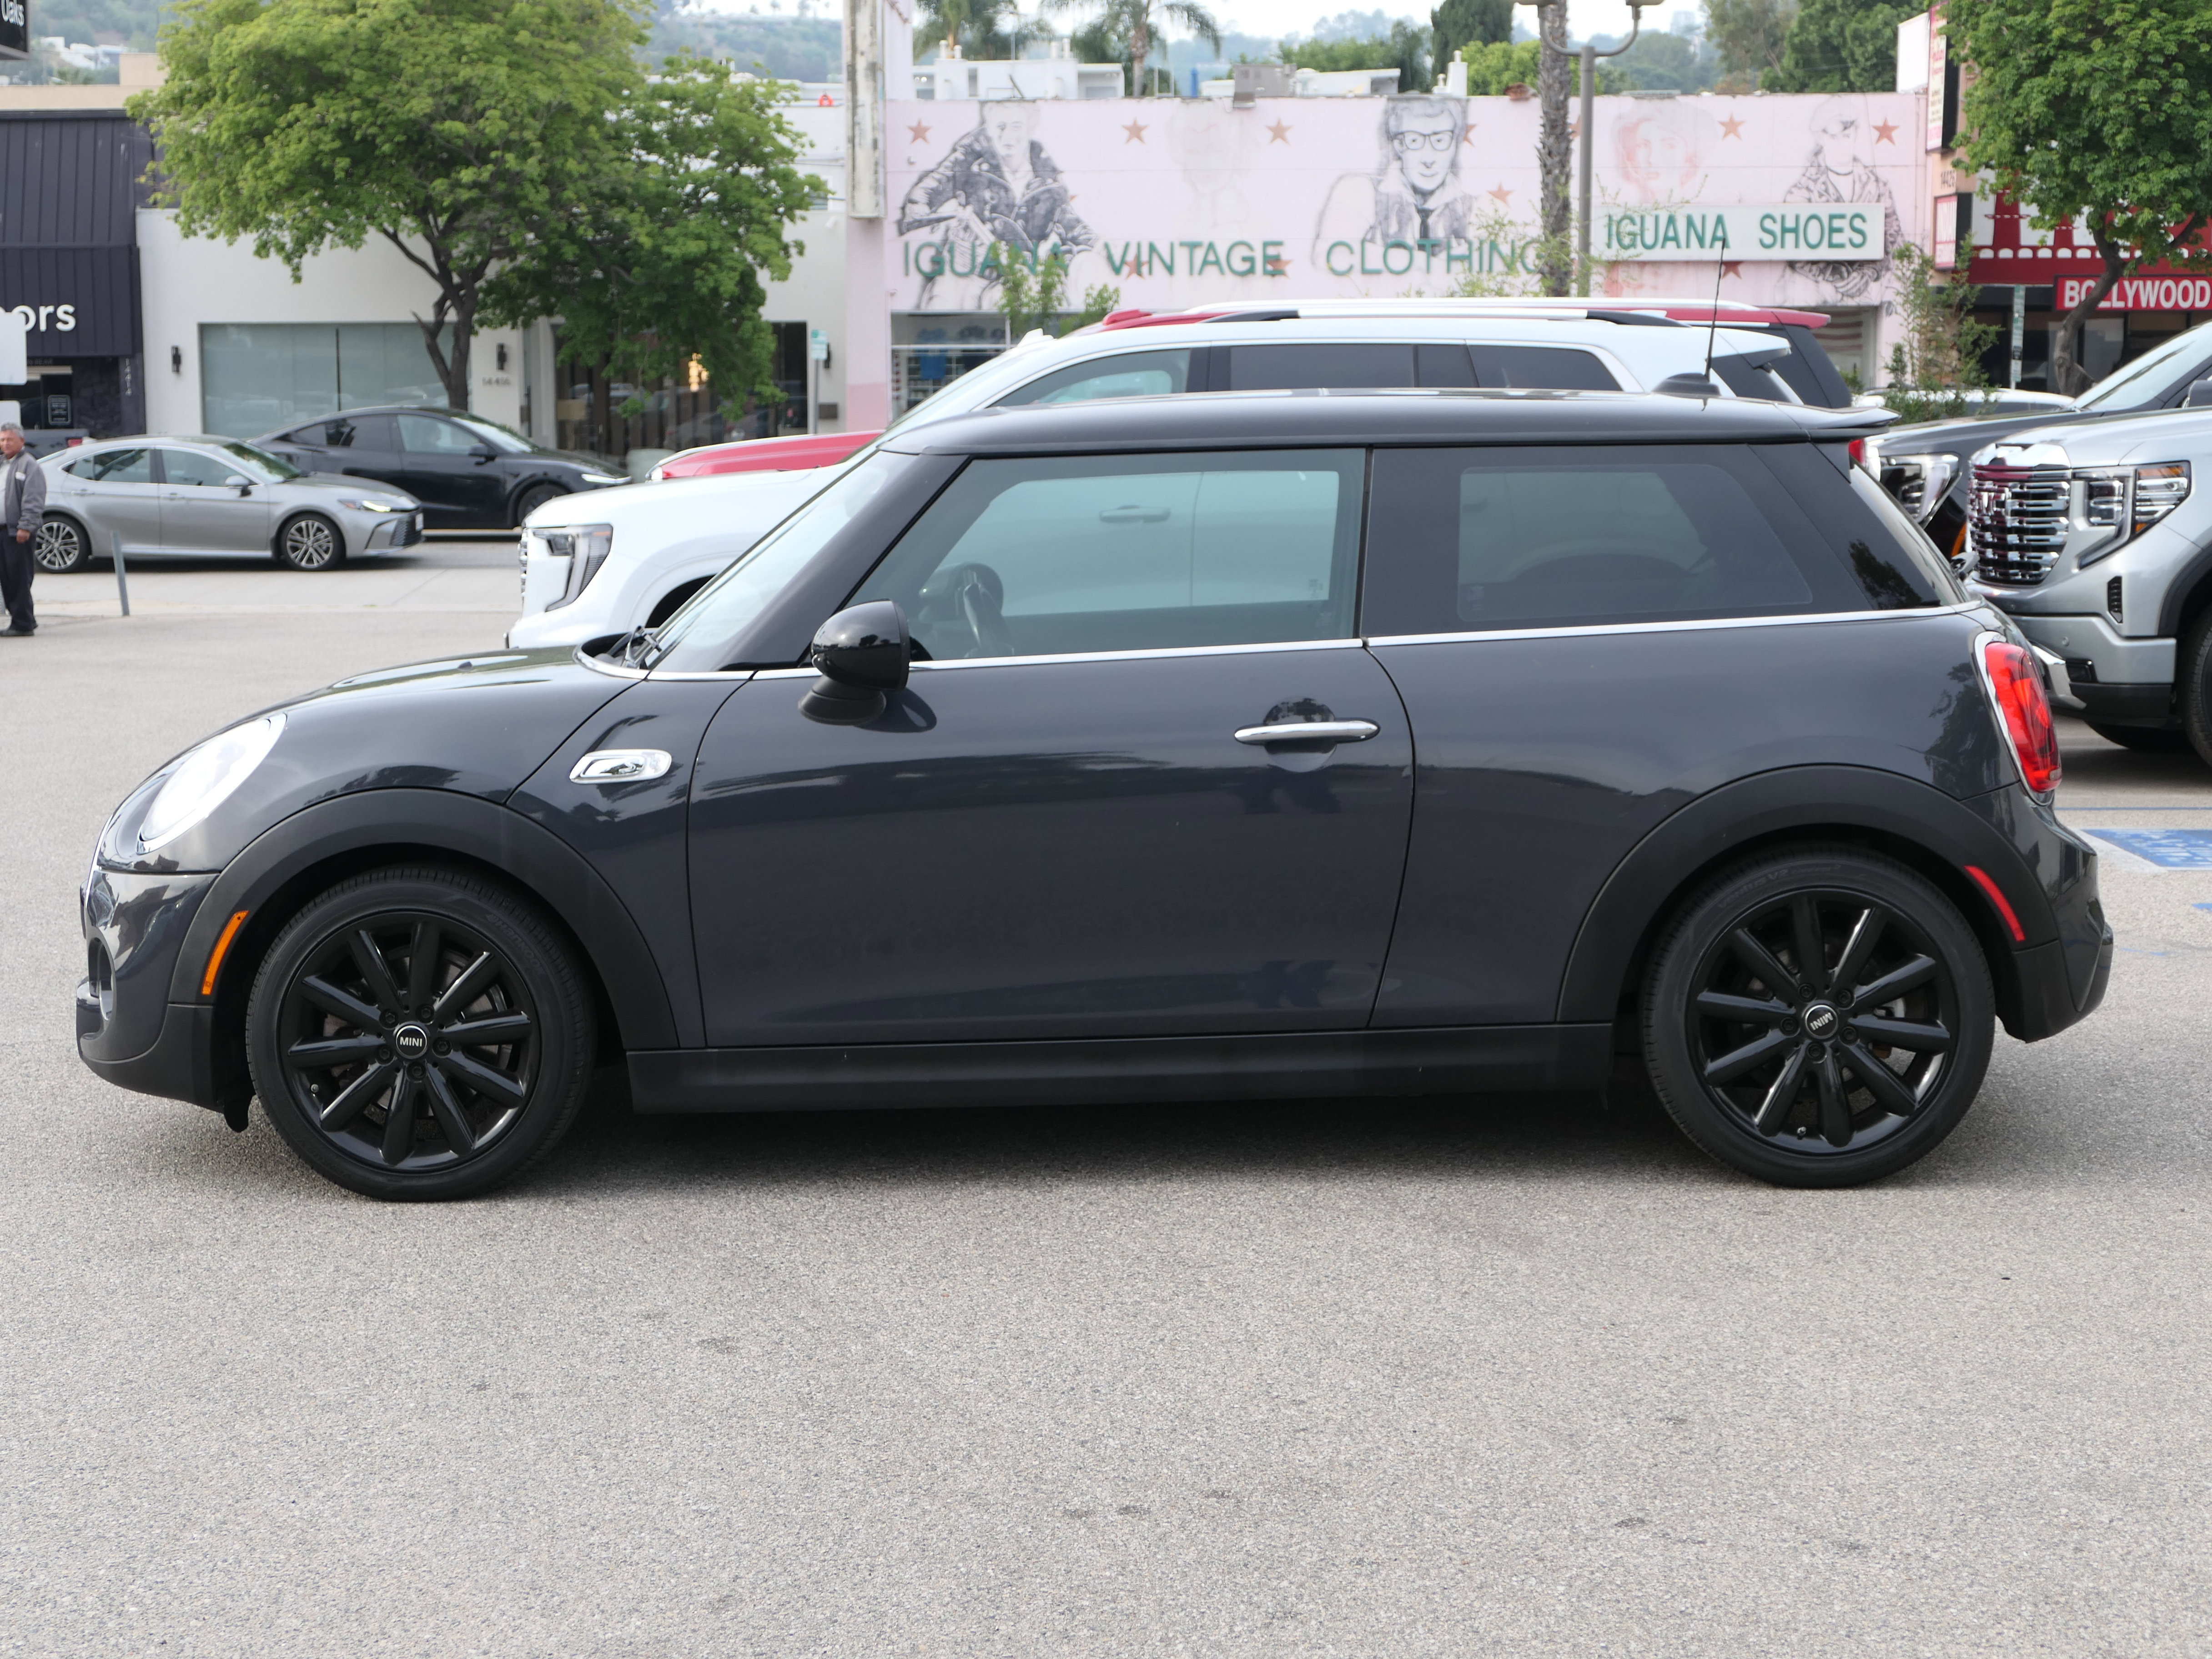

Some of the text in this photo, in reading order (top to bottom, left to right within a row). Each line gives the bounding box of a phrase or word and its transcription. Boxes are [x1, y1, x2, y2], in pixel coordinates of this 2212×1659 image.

[1607, 212, 1868, 250] IGUANA SHOES
[904, 239, 1548, 277] IGUANA VINTAGE CLOTHING
[1810, 1012, 1833, 1031] MINI
[400, 1036, 422, 1047] MINI
